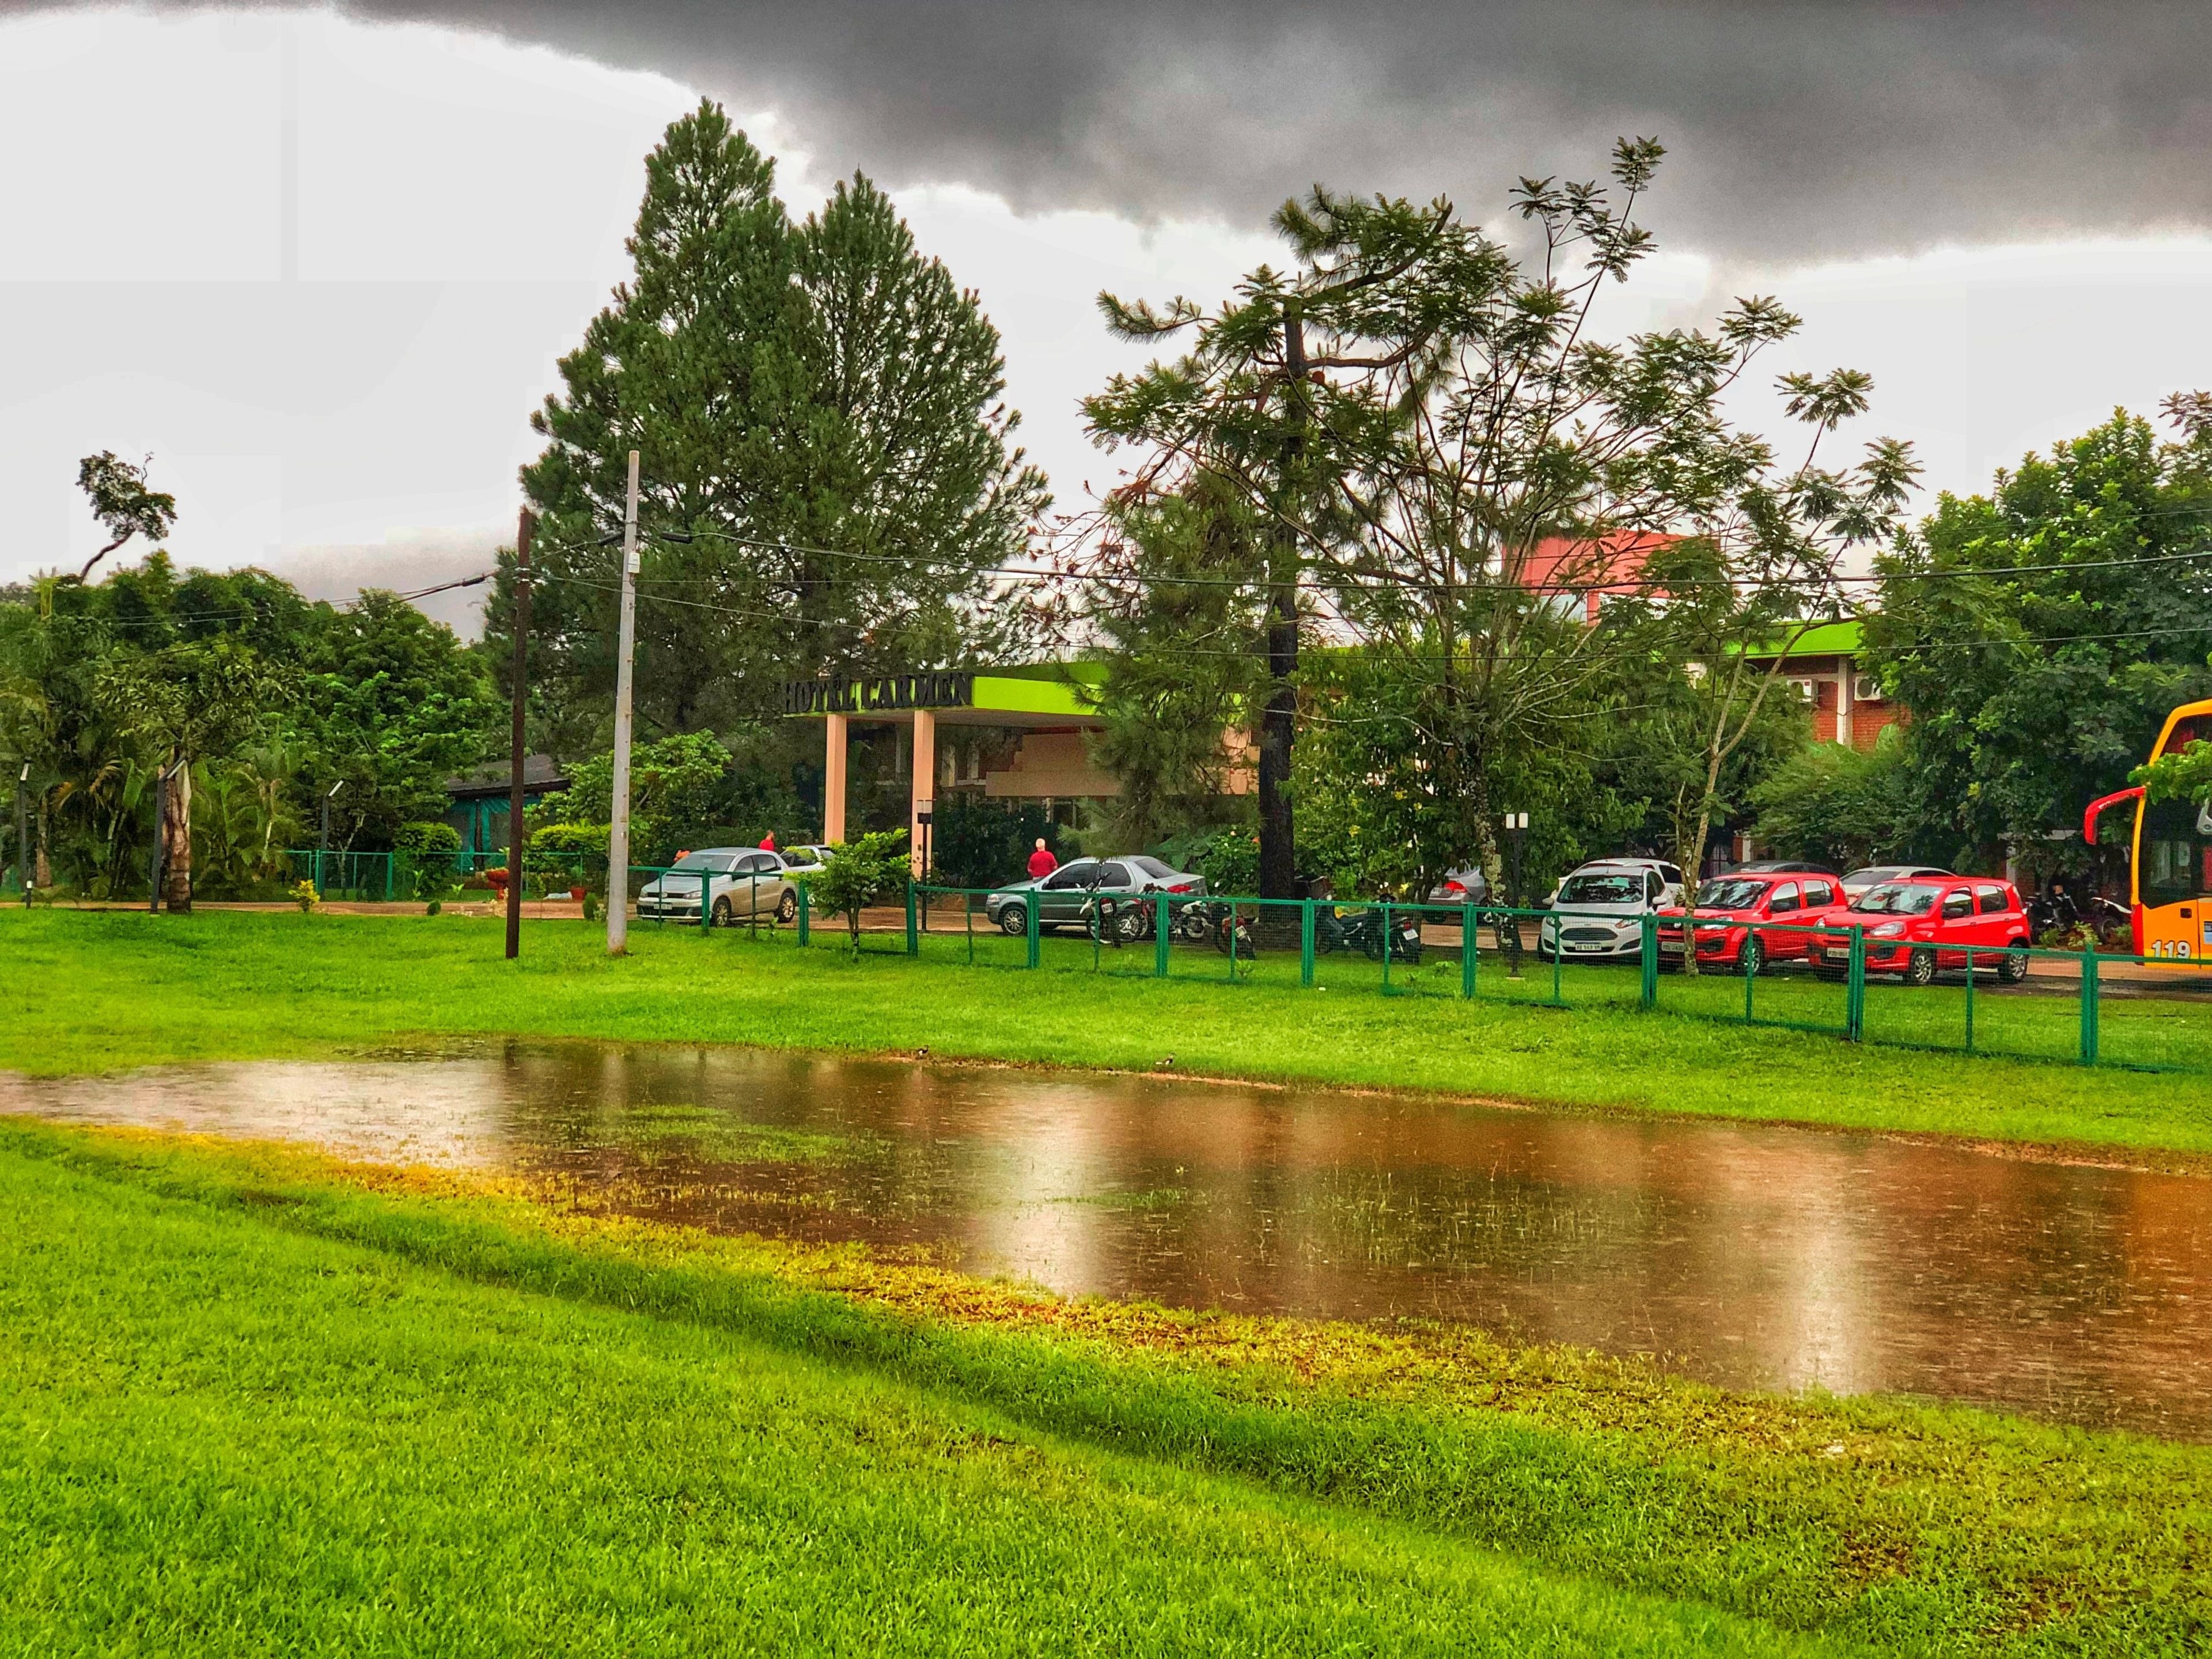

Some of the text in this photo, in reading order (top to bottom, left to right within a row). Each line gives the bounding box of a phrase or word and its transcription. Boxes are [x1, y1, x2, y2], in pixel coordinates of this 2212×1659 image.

[785, 672, 972, 713] HOTEL CARMEN
[2152, 940, 2192, 959] 119
